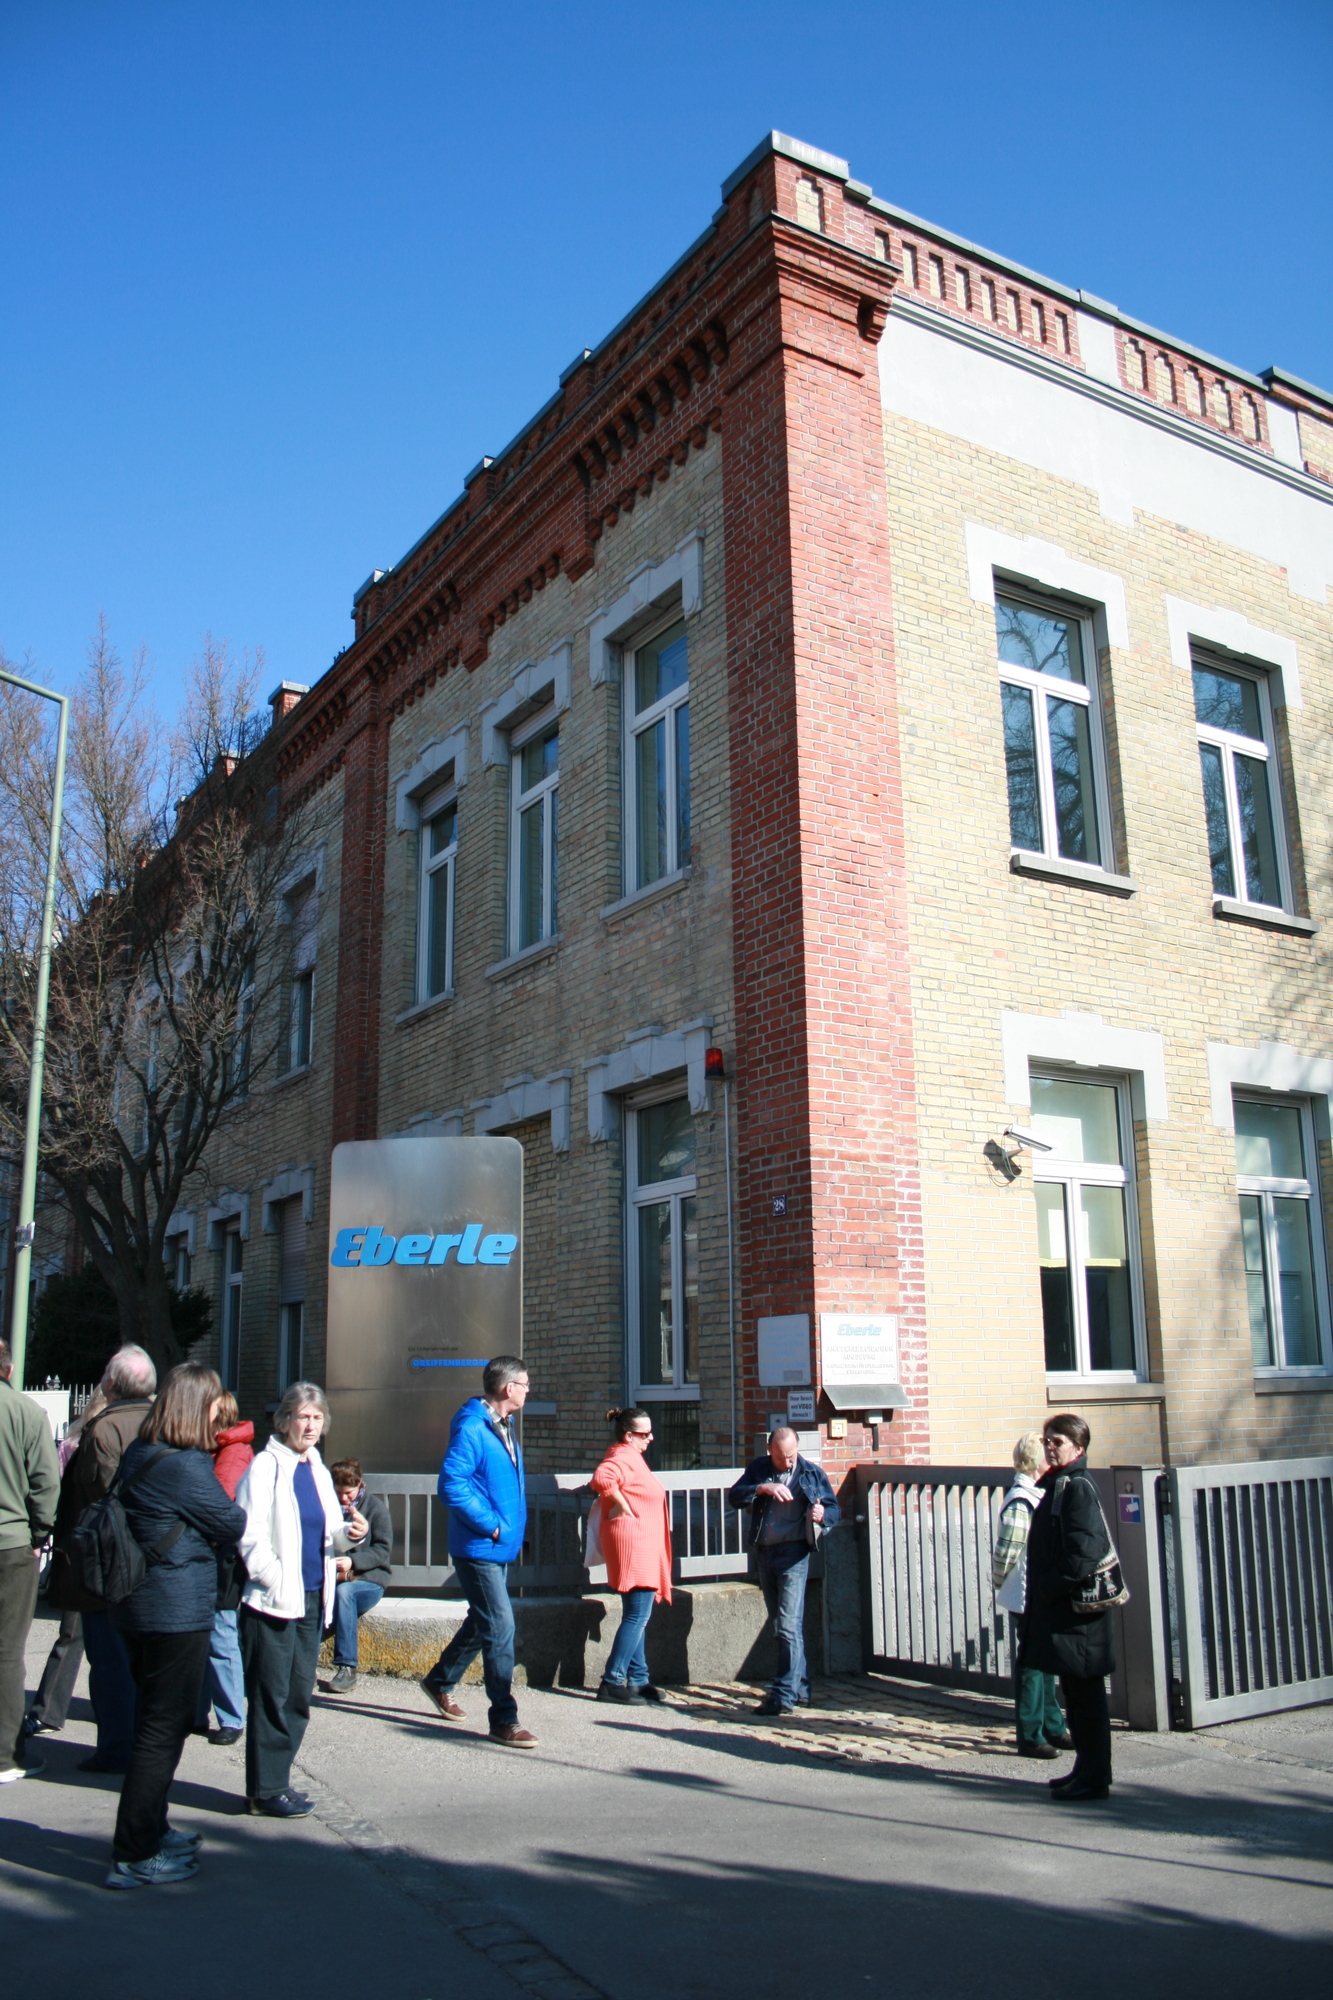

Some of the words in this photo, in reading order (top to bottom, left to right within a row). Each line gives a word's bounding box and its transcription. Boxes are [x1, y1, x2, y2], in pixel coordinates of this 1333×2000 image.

[774, 1198, 785, 1212] 28
[330, 1223, 518, 1268] Eberle
[837, 1324, 882, 1336] Eberle
